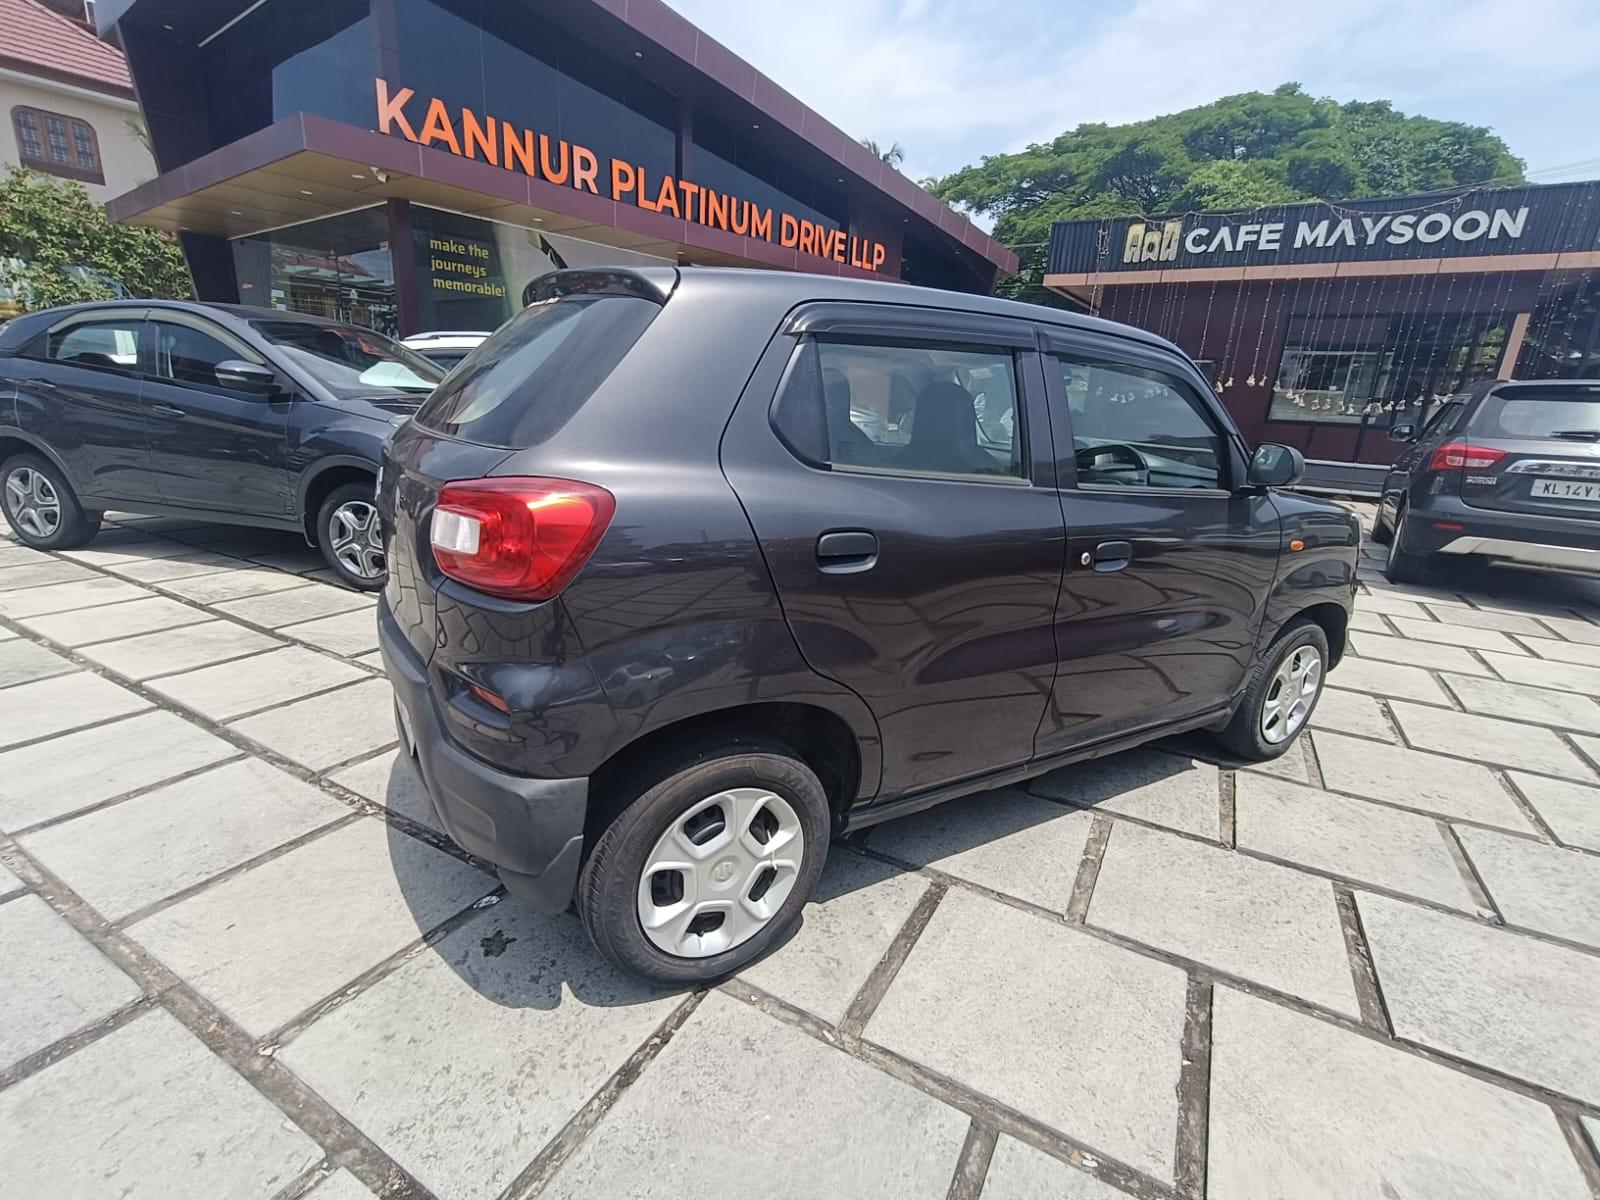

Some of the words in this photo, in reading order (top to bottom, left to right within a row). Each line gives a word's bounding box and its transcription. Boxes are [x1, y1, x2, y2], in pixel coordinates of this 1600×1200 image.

[376, 78, 599, 195] KANNUR
[610, 158, 772, 242] PLATINUM
[780, 212, 847, 264] DRIVE
[851, 236, 885, 271] LLP
[1185, 223, 1284, 254] CAFE
[1293, 207, 1529, 249] MAYSOON
[430, 239, 465, 254] make
[468, 243, 489, 259] the
[431, 255, 487, 278] journeys
[432, 278, 506, 297] memorable!
